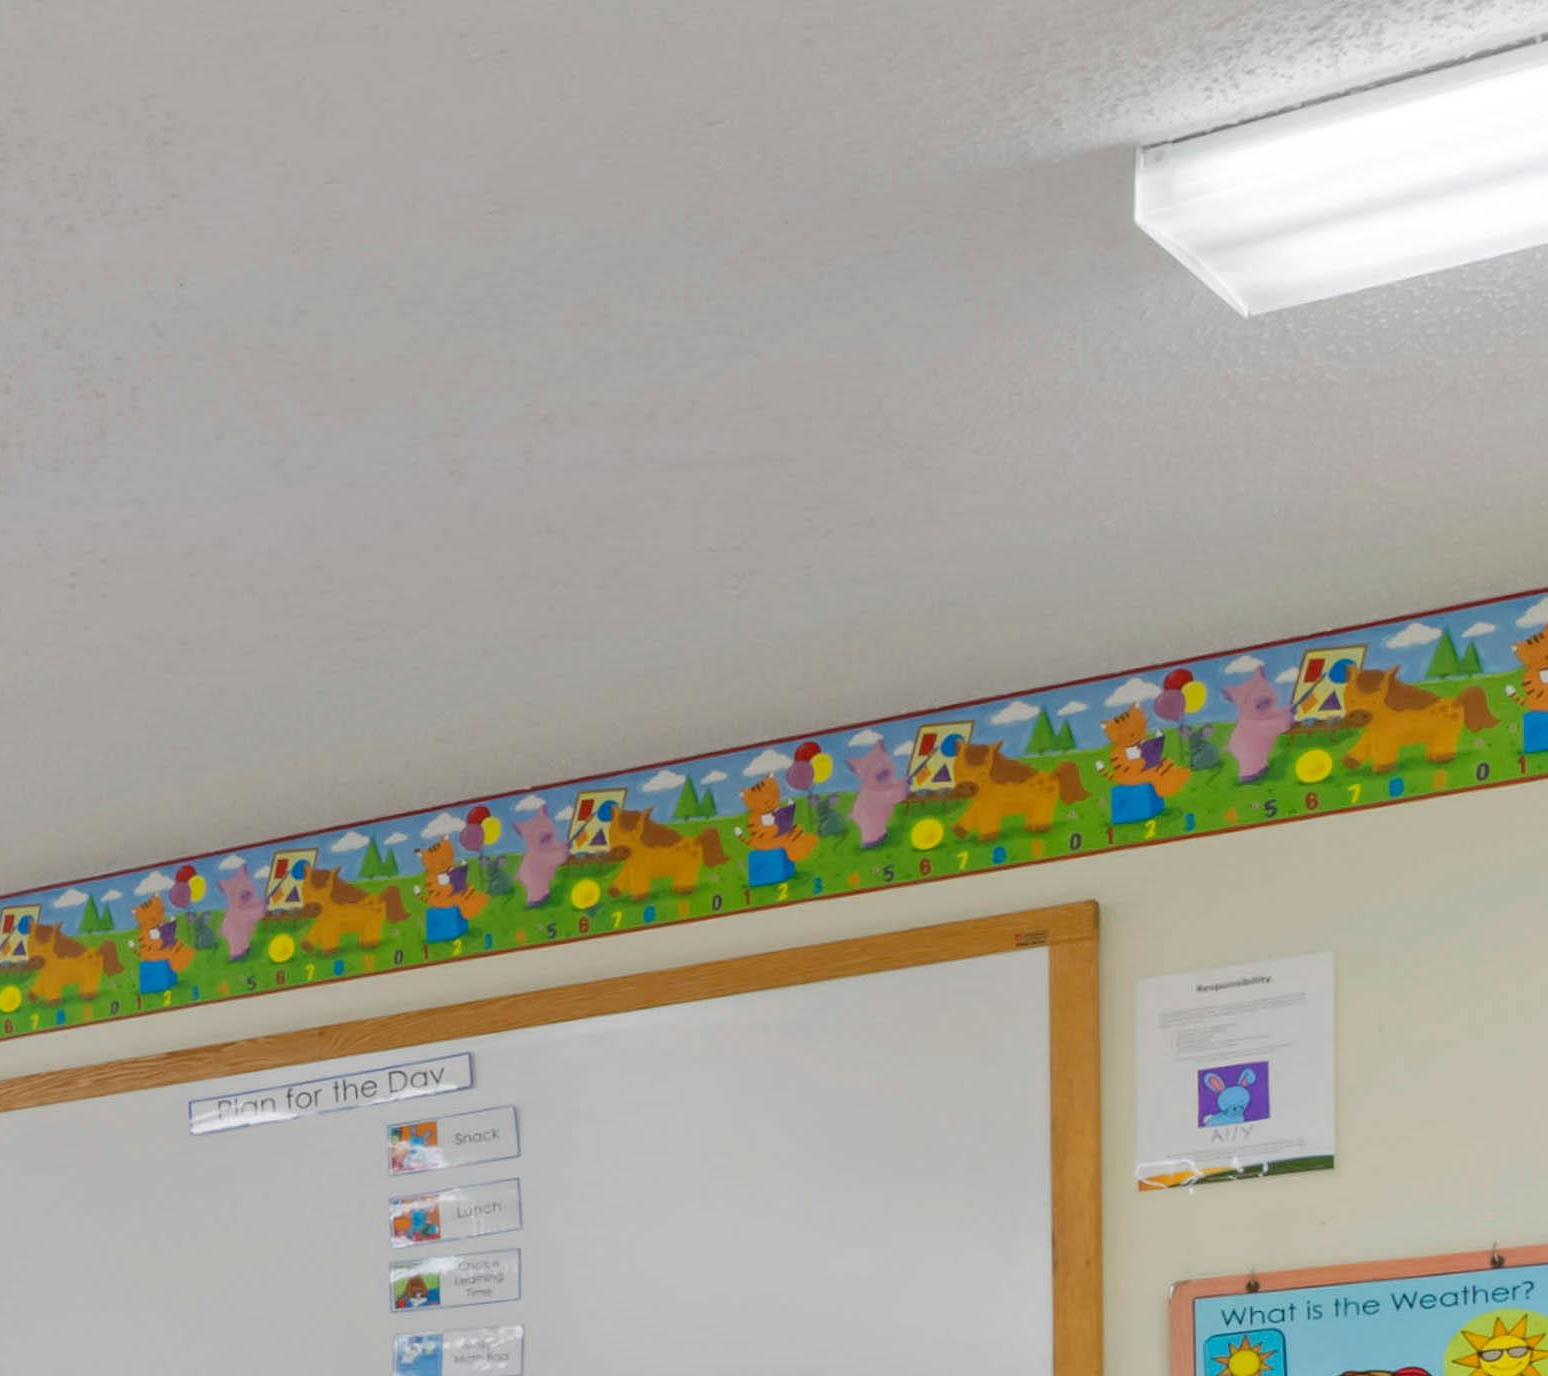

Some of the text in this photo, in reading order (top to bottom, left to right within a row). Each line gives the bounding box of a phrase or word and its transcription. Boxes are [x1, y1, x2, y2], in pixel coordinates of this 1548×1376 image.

[286, 1086, 322, 1110] for
[332, 1079, 377, 1103] the
[388, 1066, 446, 1094] Day
[455, 1127, 500, 1146] Snack
[456, 1200, 502, 1219] Lunch
[1221, 1281, 1535, 1326] What is the Weather?
